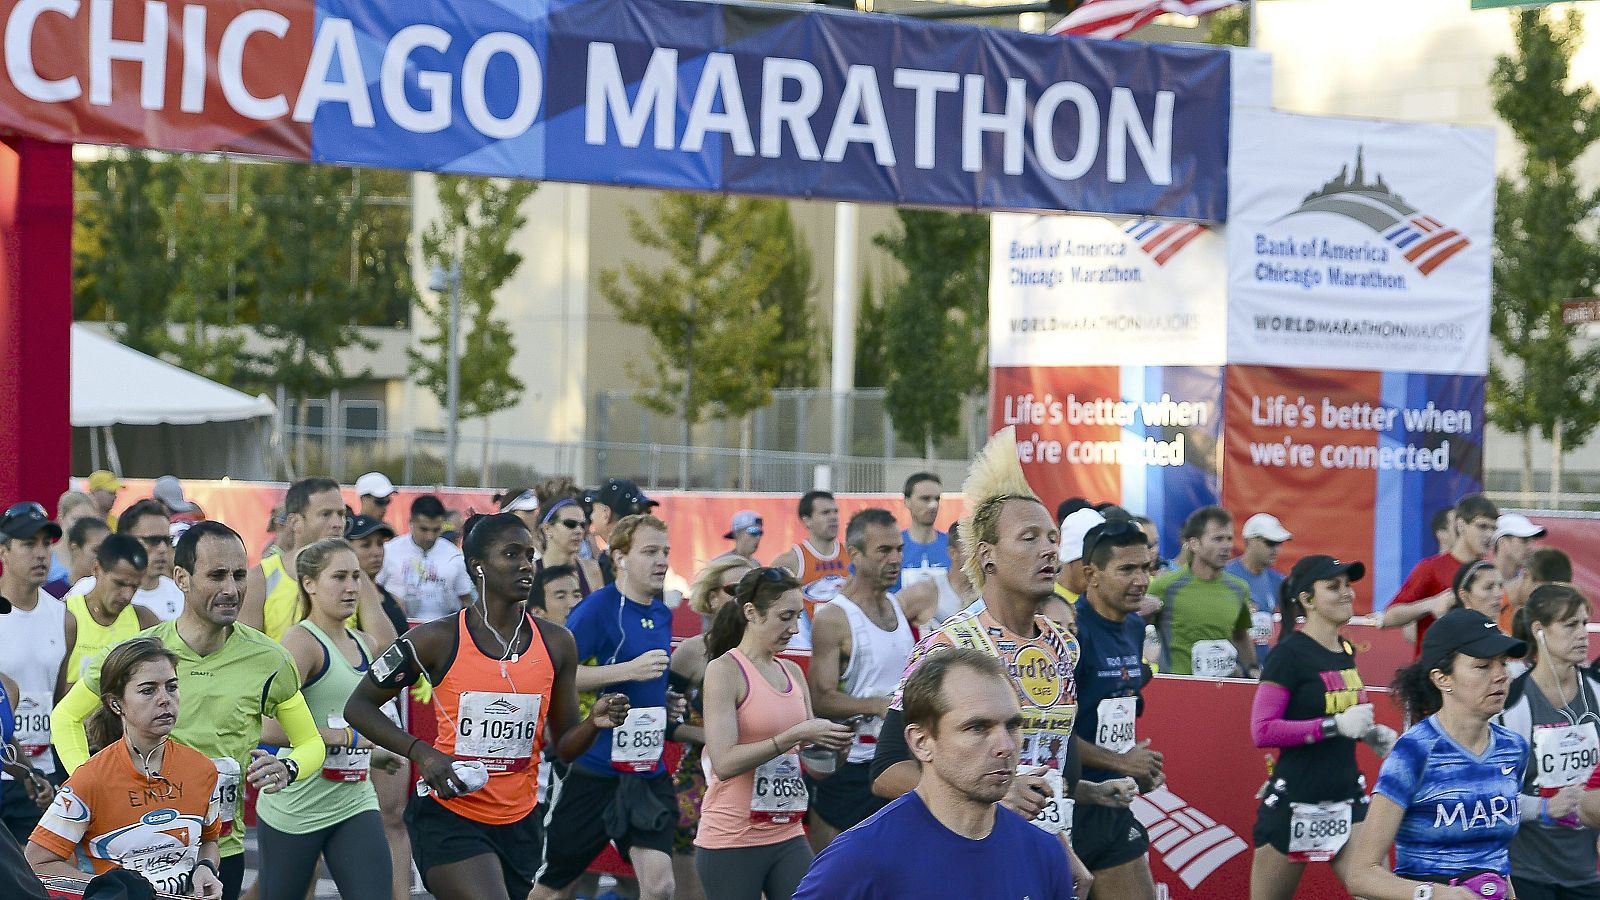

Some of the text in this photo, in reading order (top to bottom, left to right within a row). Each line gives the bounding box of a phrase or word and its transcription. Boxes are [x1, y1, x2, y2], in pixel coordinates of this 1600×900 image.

[4, 0, 1176, 187] CHICAGO MARATHON
[1255, 234, 1389, 262] Bank of America
[1255, 262, 1407, 290] Chicago Marathon
[1003, 392, 1208, 427] Life's better when
[1252, 394, 1472, 434] Life's better when
[1066, 432, 1186, 467] connted
[1250, 435, 1450, 471] we're connected
[14, 714, 50, 732] 9130
[460, 717, 535, 740] C 10516
[1099, 724, 1108, 743] C
[617, 730, 628, 748] C
[1543, 748, 1598, 773] C 7590
[128, 781, 184, 807] EMILY
[757, 777, 768, 796] C
[1295, 820, 1347, 839] C 9888
